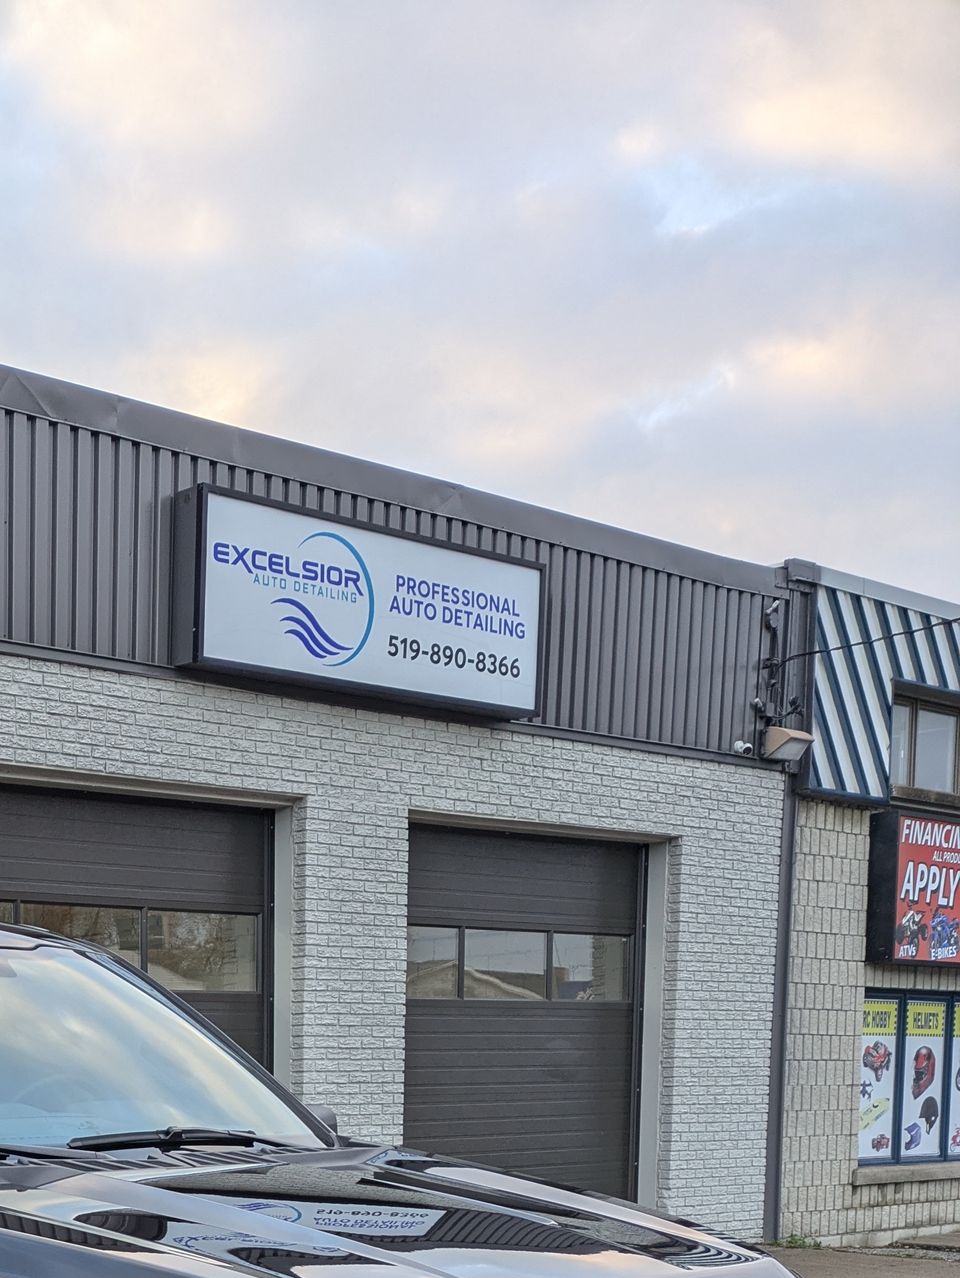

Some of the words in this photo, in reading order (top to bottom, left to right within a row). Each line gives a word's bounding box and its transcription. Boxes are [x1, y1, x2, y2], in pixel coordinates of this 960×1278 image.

[213, 541, 365, 597] EXCELSIOR
[253, 573, 288, 590] AUTO
[293, 580, 358, 604] DETAILING
[395, 574, 521, 618] PROFESSIONAL
[389, 595, 438, 621] AUTO
[442, 609, 526, 639] DETAILING
[387, 635, 521, 679] 519-890-8366
[932, 850, 942, 862] ALL
[900, 861, 960, 907] APPLY
[899, 944, 916, 958] ATVs
[931, 946, 957, 961] E-BIKES
[871, 1010, 892, 1029] HOBBY
[912, 1011, 939, 1030] HELMETS
